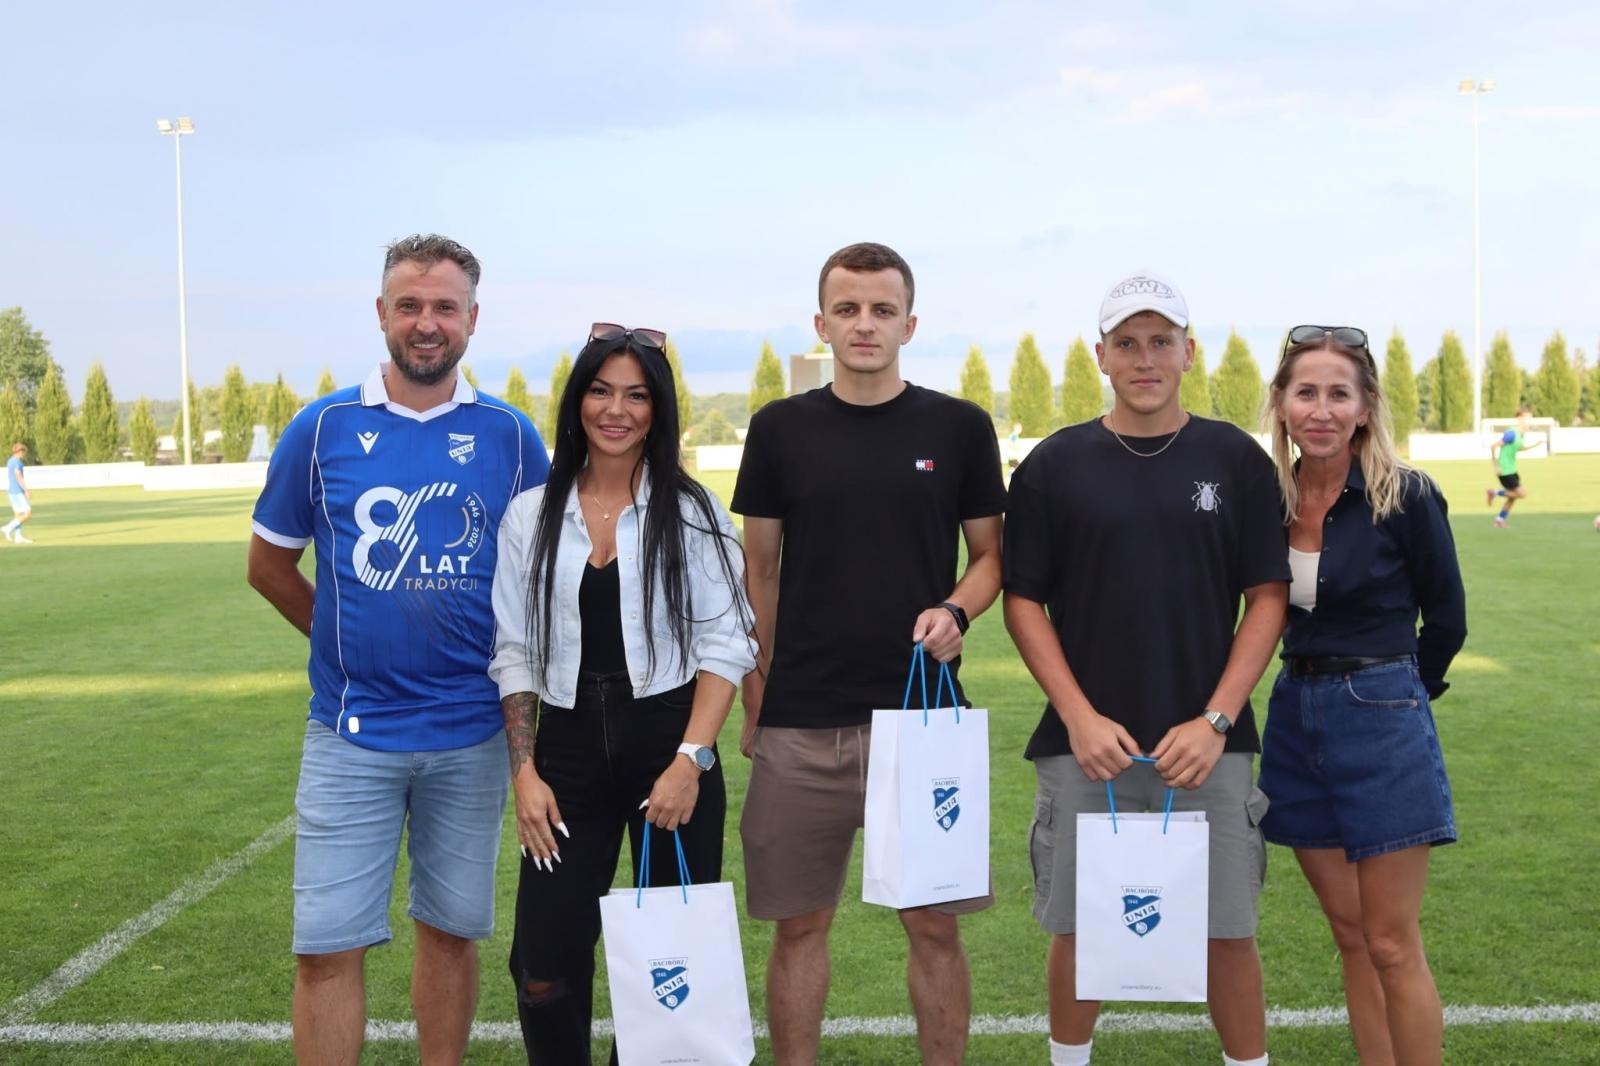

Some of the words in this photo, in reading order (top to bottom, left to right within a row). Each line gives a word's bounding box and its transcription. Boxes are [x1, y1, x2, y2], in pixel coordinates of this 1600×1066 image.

[465, 495, 480, 518] 1946
[352, 482, 470, 591] 80
[467, 526, 480, 549] 2026
[420, 554, 470, 575] LAT
[404, 578, 478, 591] TRADYCJI
[935, 797, 957, 817] UNIA
[1125, 905, 1156, 922] UNIA
[655, 976, 684, 996] UNIA
